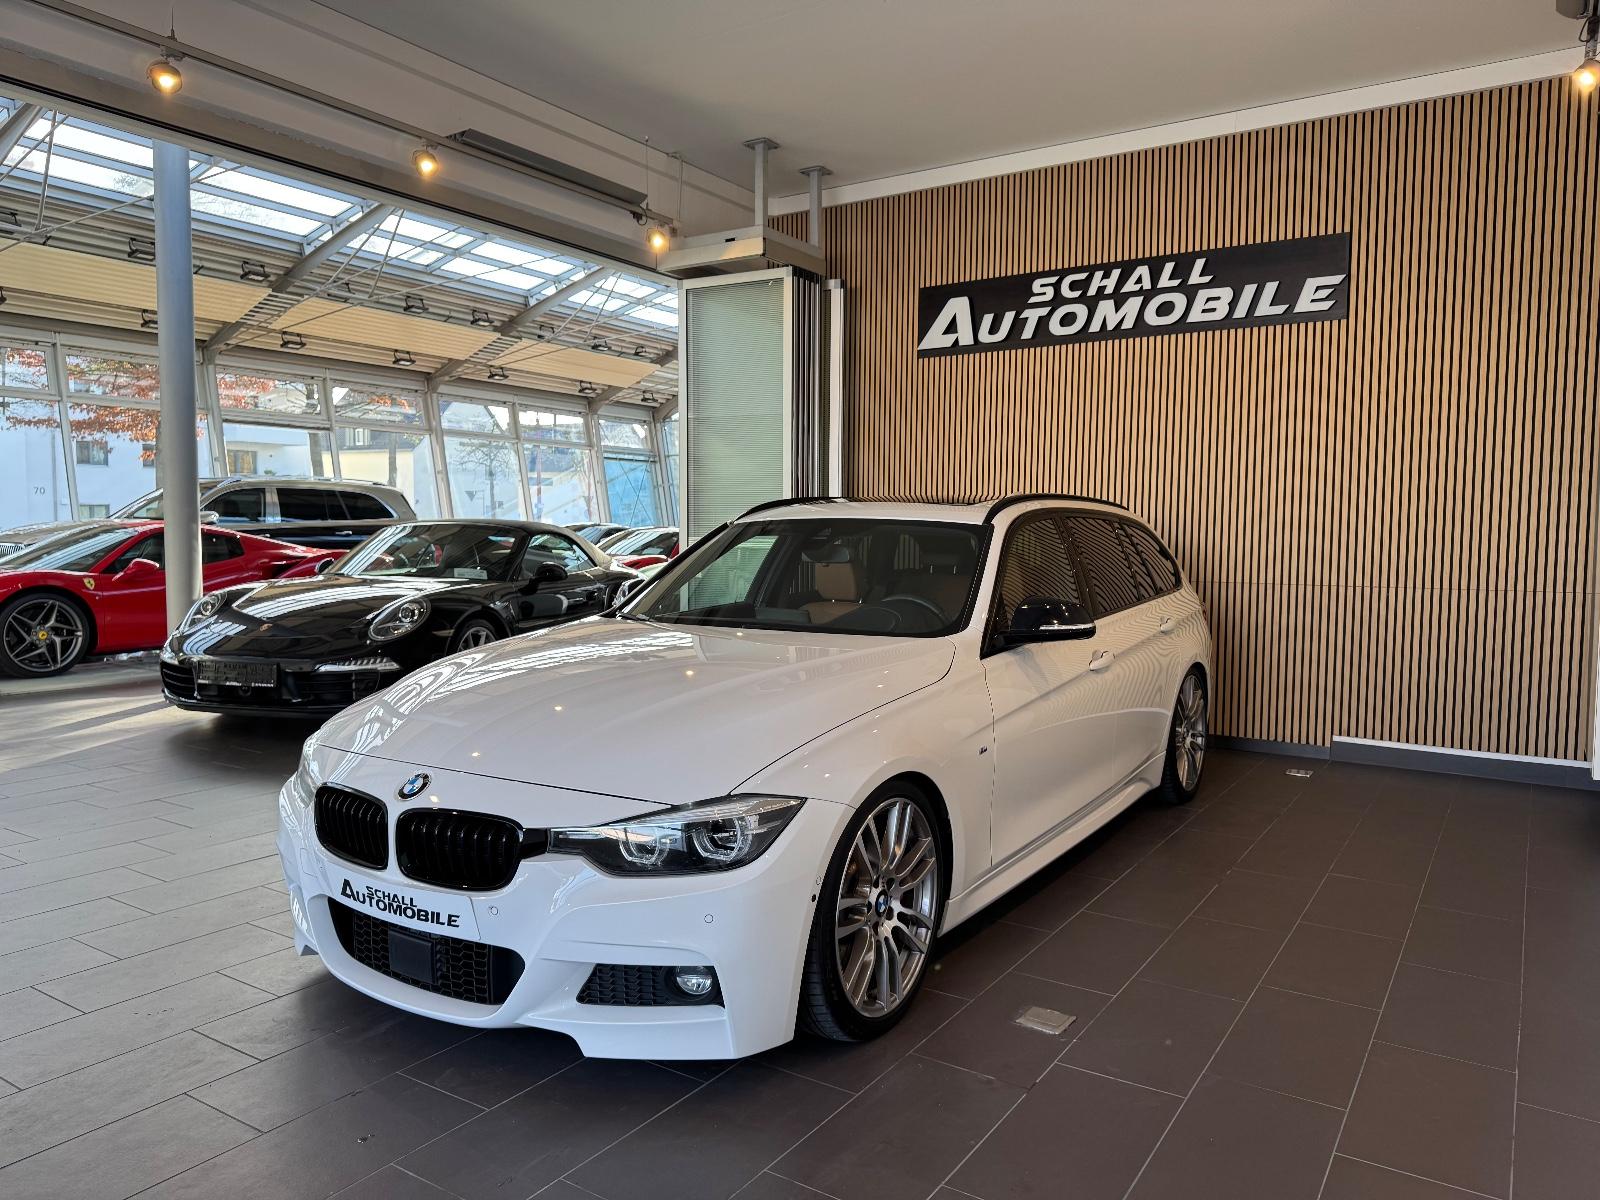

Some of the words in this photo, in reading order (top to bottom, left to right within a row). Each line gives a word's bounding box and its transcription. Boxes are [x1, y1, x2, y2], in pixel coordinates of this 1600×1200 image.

[1028, 258, 1215, 304] SCHALL
[917, 274, 1347, 351] AUTOMOBILE
[33, 486, 46, 495] 70
[341, 879, 460, 928] AUTOMOBILE
[365, 885, 418, 908] SCHALL
